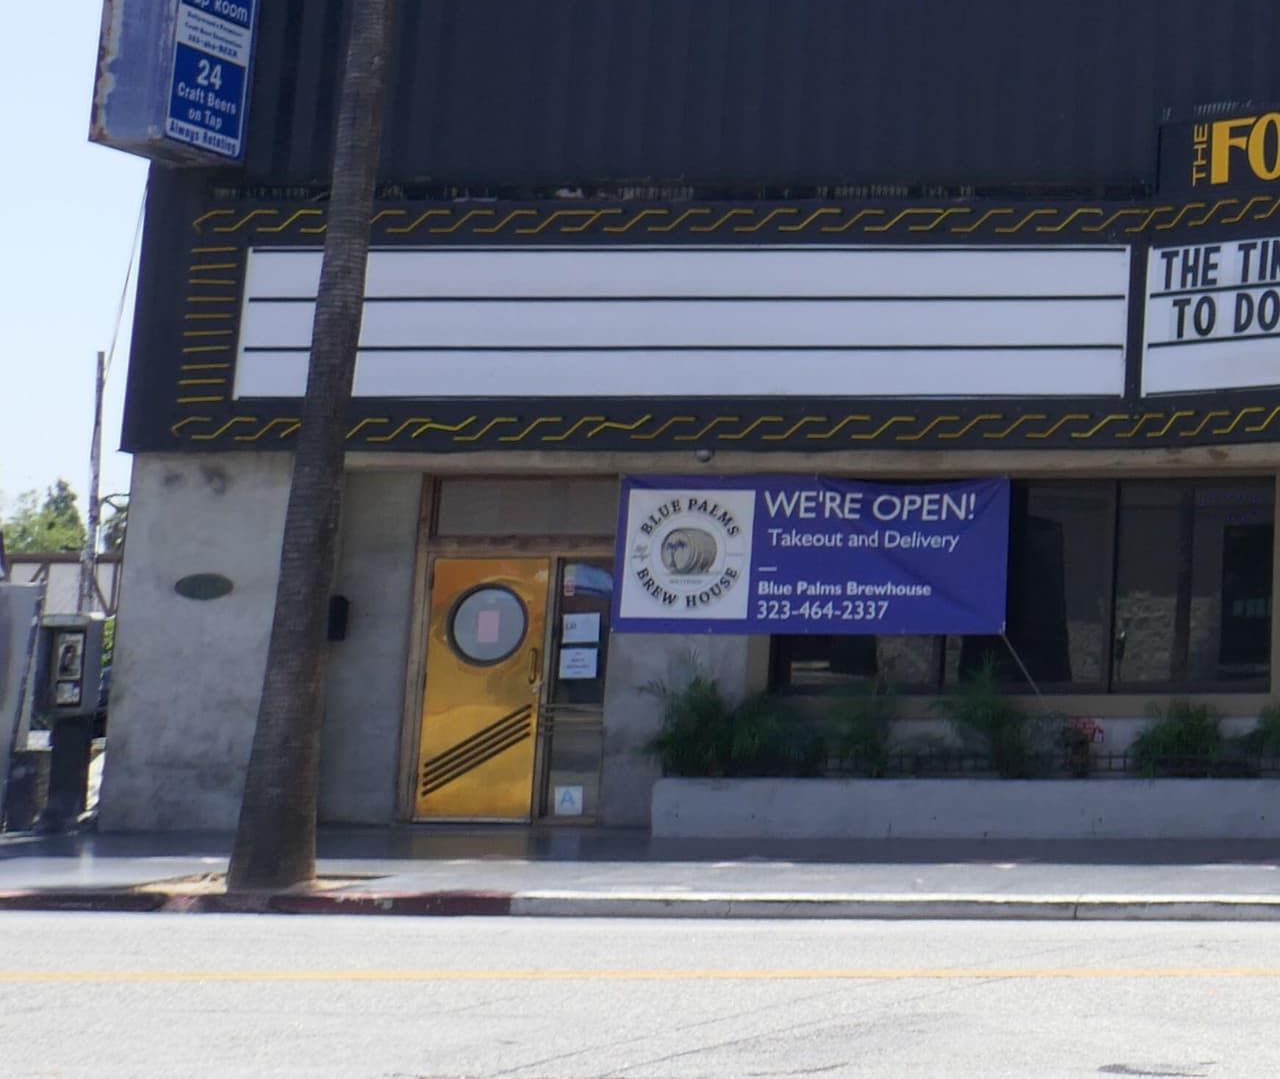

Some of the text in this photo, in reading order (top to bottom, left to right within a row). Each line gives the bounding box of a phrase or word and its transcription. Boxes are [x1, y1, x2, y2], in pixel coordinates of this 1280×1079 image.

[197, 58, 223, 90] 24
[177, 81, 237, 115] Craft Beers
[188, 108, 223, 131] on Tap
[1193, 123, 1208, 187] THE
[1161, 246, 1222, 291] THE
[1172, 296, 1217, 339] TO
[1235, 290, 1280, 334] DO
[640, 498, 740, 537] BLUE PALMS
[764, 490, 976, 521] WE'RE OPEN!
[768, 528, 960, 552] Takeout and Delivery
[637, 567, 738, 608] BREW HOUSE
[758, 580, 932, 597] Blue Palms Brewhouse
[757, 600, 889, 620] 323-464-2337
[560, 789, 576, 805] A
